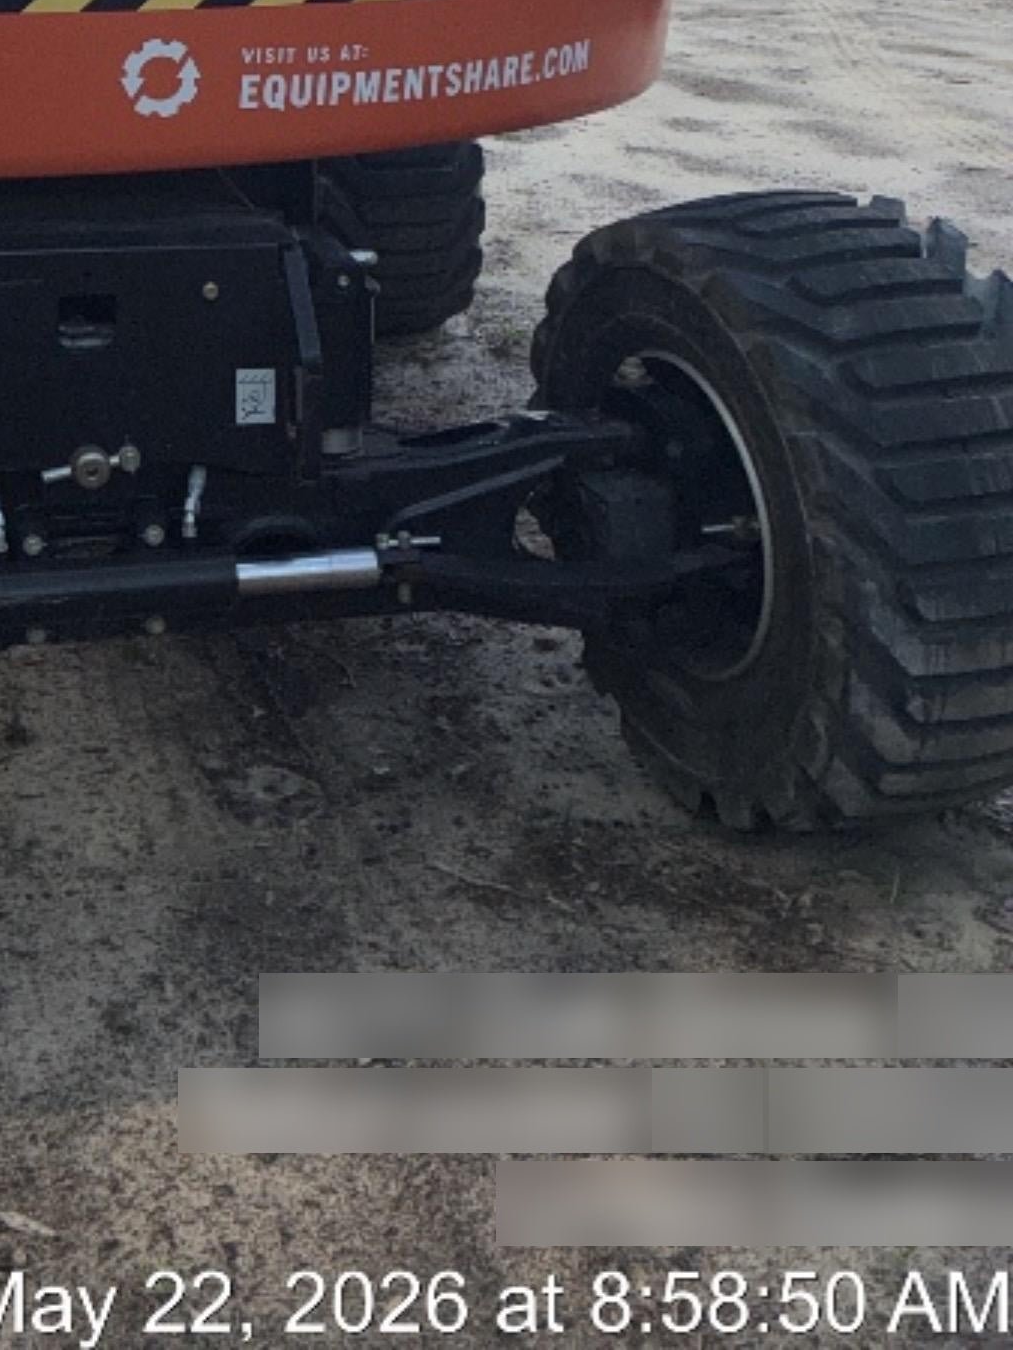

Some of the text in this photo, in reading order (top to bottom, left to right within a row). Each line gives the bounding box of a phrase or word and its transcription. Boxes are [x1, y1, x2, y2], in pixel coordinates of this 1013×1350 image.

[238, 37, 591, 112] EQUIPMENTSHARE.COM
[240, 43, 369, 65] VISIT US AT:
